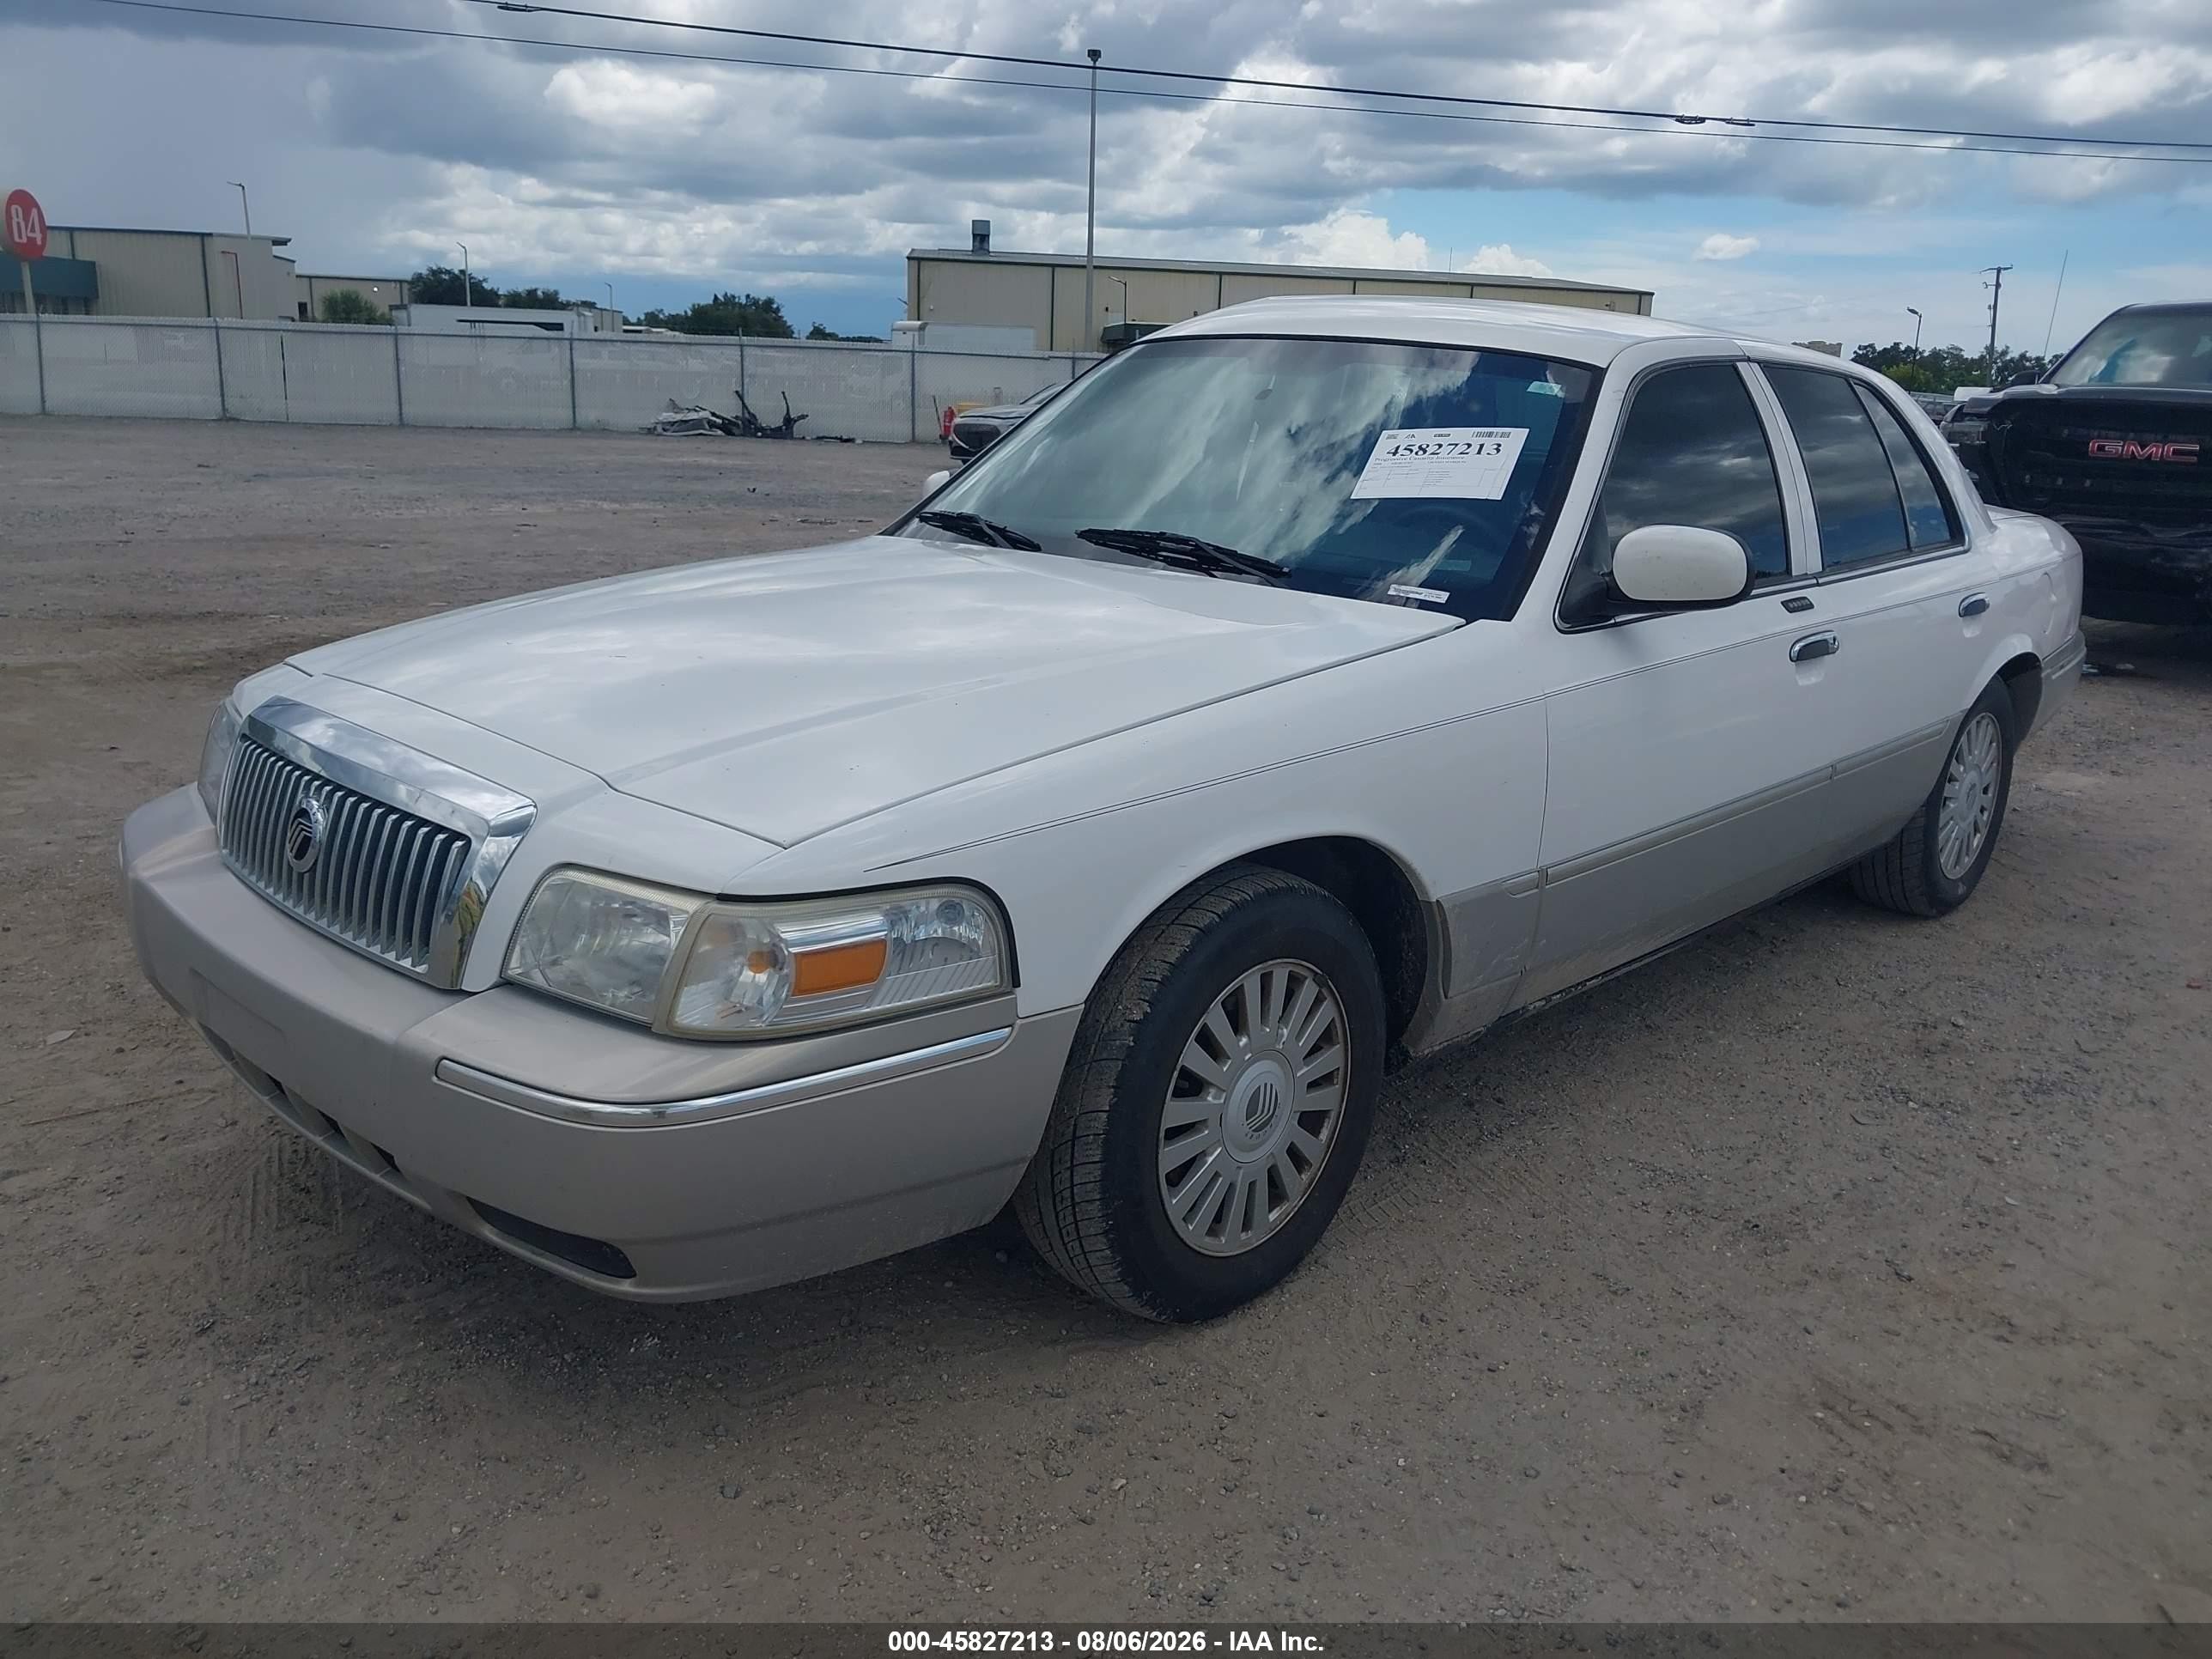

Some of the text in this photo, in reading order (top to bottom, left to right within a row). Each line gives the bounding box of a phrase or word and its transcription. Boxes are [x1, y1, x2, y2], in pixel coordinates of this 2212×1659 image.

[10, 204, 42, 246] 84
[1386, 442, 1503, 457] 45827213
[2088, 439, 2200, 463] GMC
